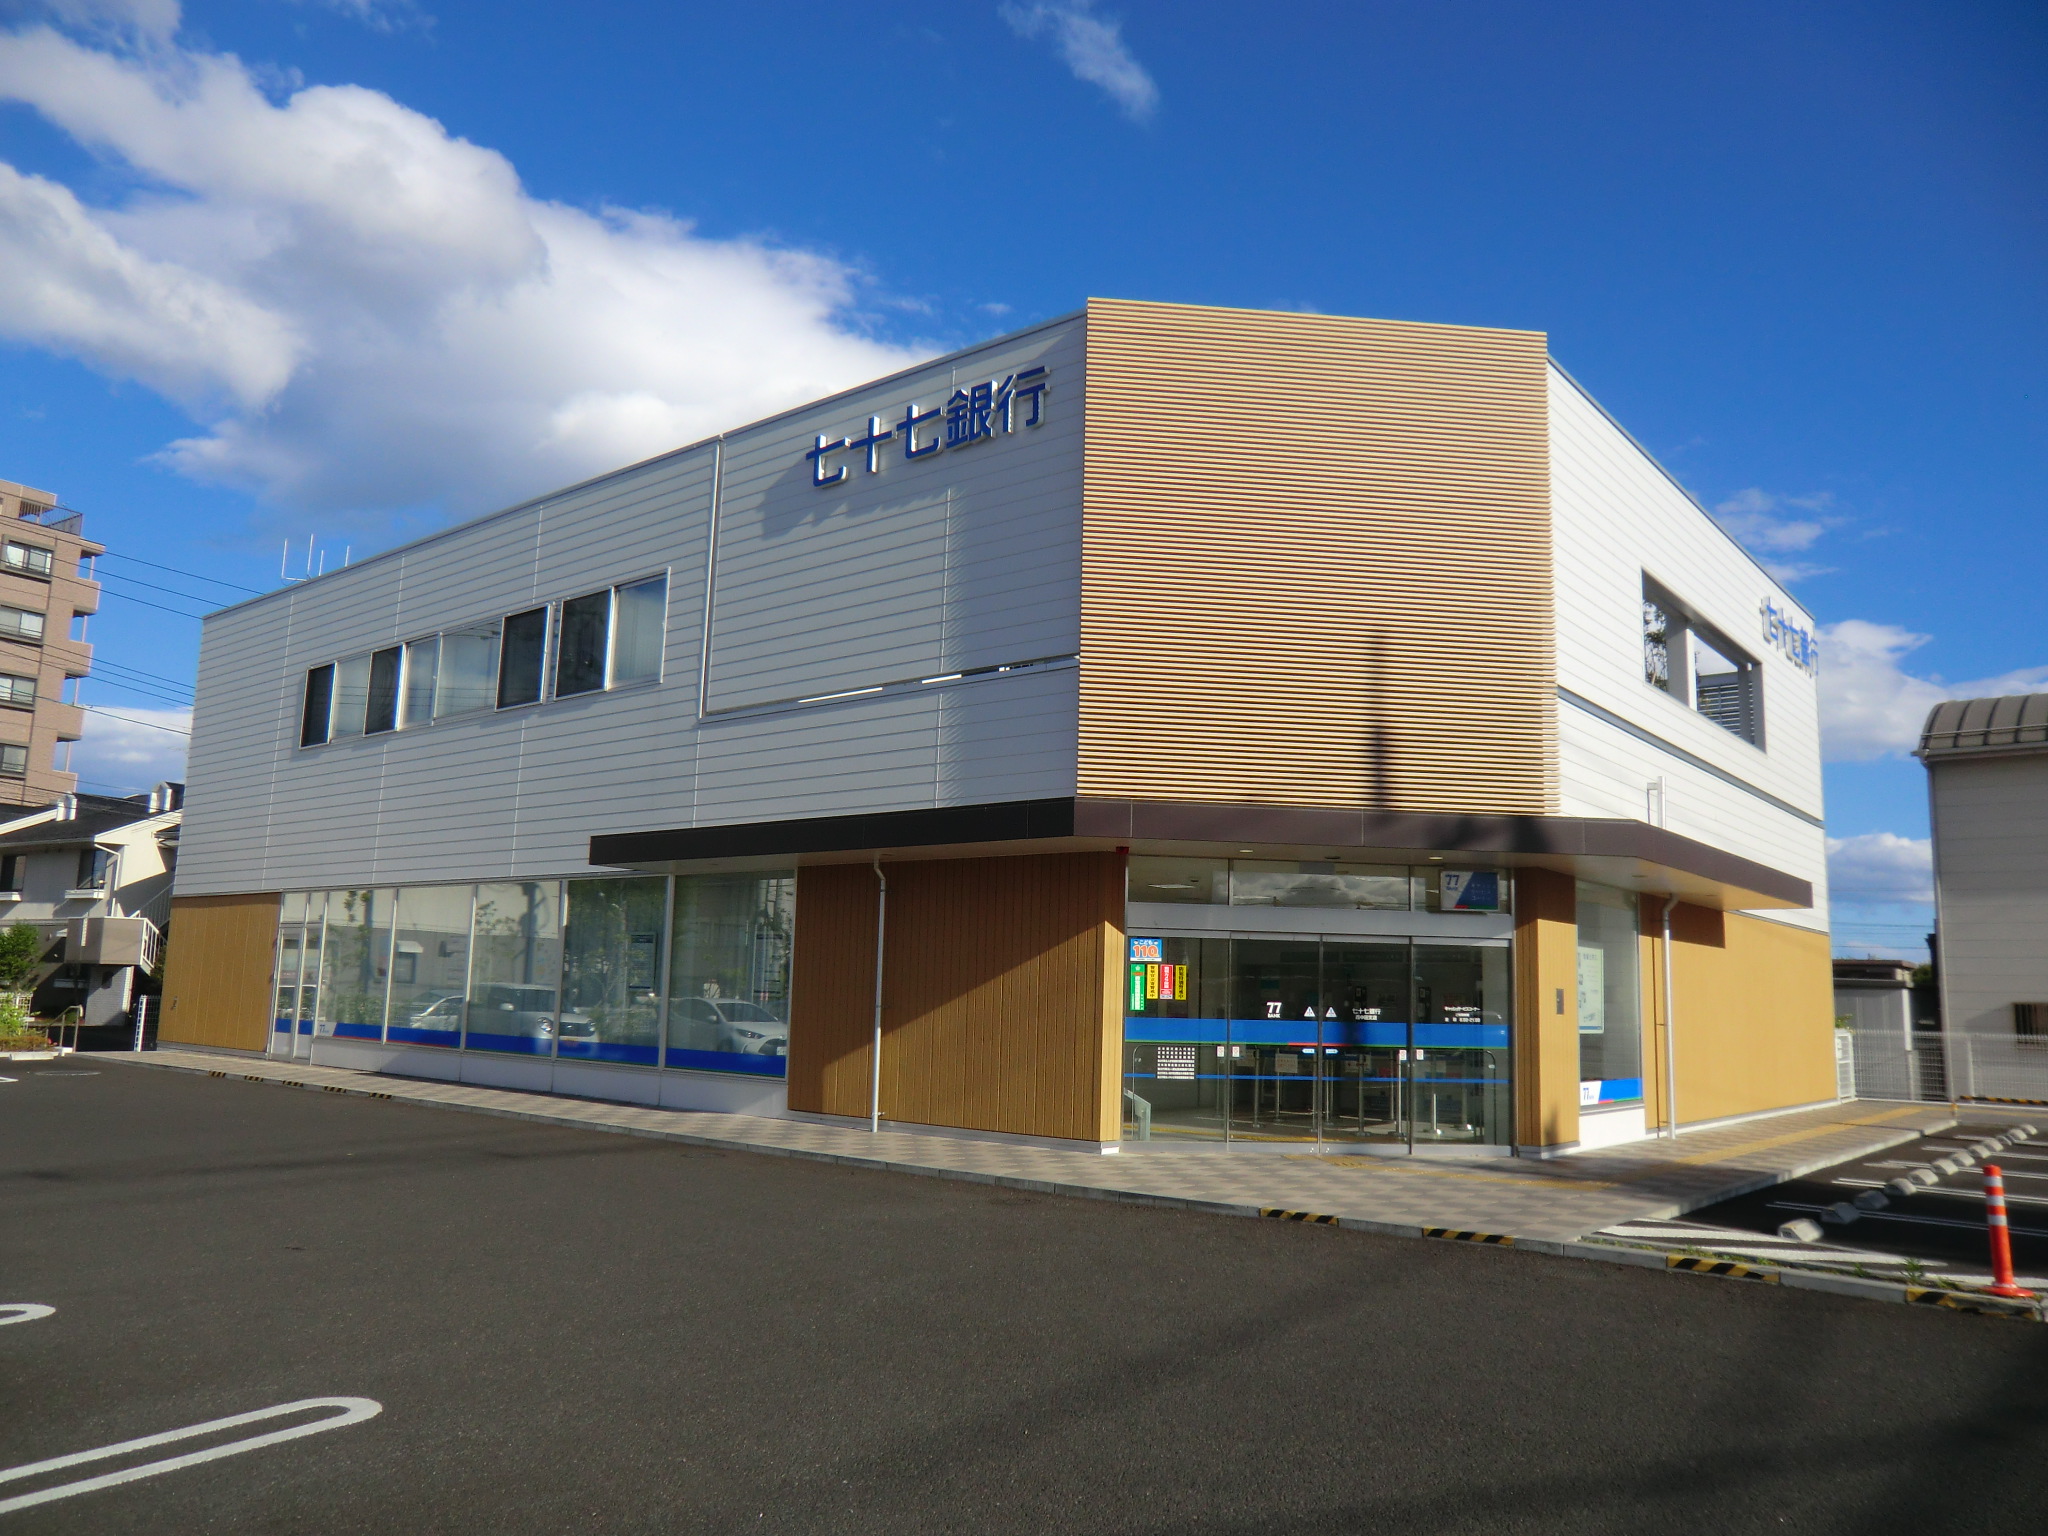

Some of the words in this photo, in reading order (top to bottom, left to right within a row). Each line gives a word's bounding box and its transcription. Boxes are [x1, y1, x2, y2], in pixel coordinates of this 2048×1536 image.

[806, 365, 1050, 488] 七十七銀行
[1444, 874, 1460, 886] 77
[1266, 1001, 1282, 1014] 77
